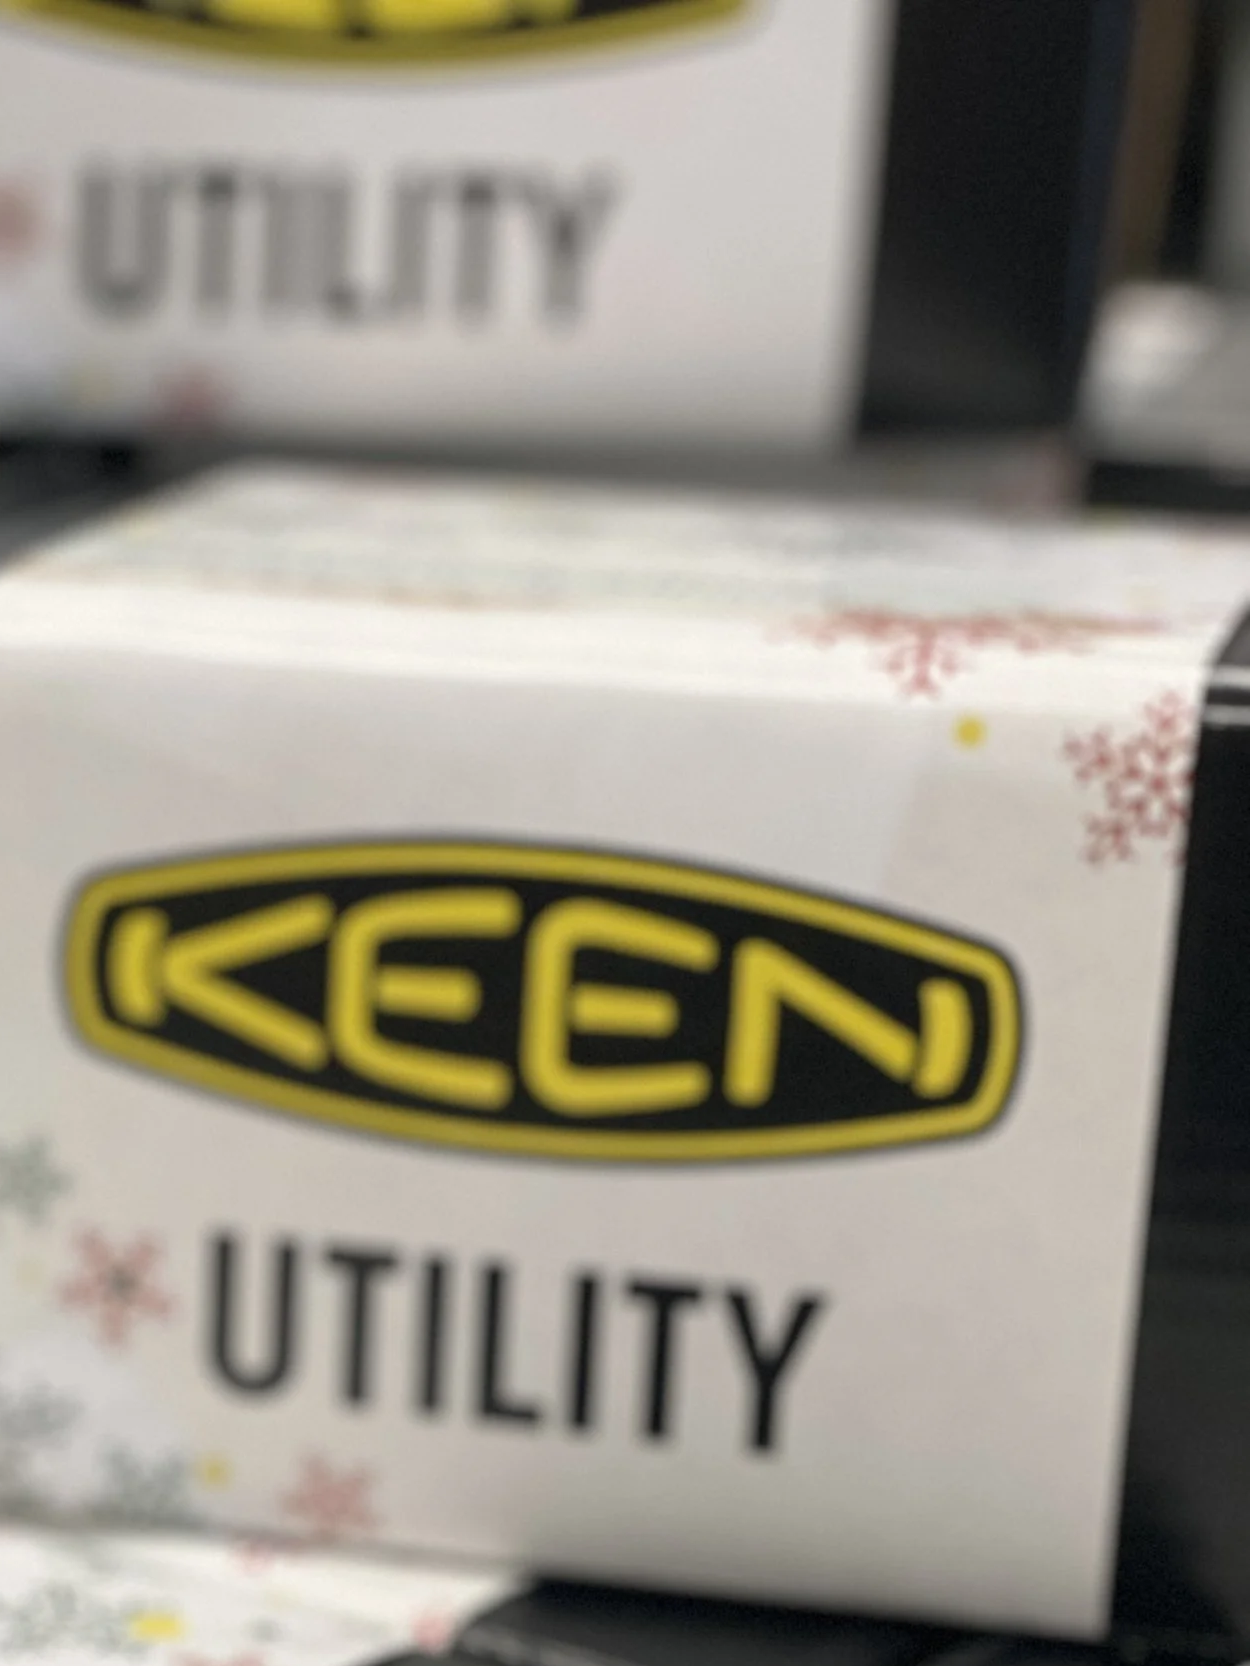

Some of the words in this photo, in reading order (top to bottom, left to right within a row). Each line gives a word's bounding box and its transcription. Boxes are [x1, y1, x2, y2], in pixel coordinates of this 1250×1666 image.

[72, 160, 622, 325] UTILITY
[106, 888, 970, 1114] KEEN
[202, 1228, 828, 1458] UTILITY
